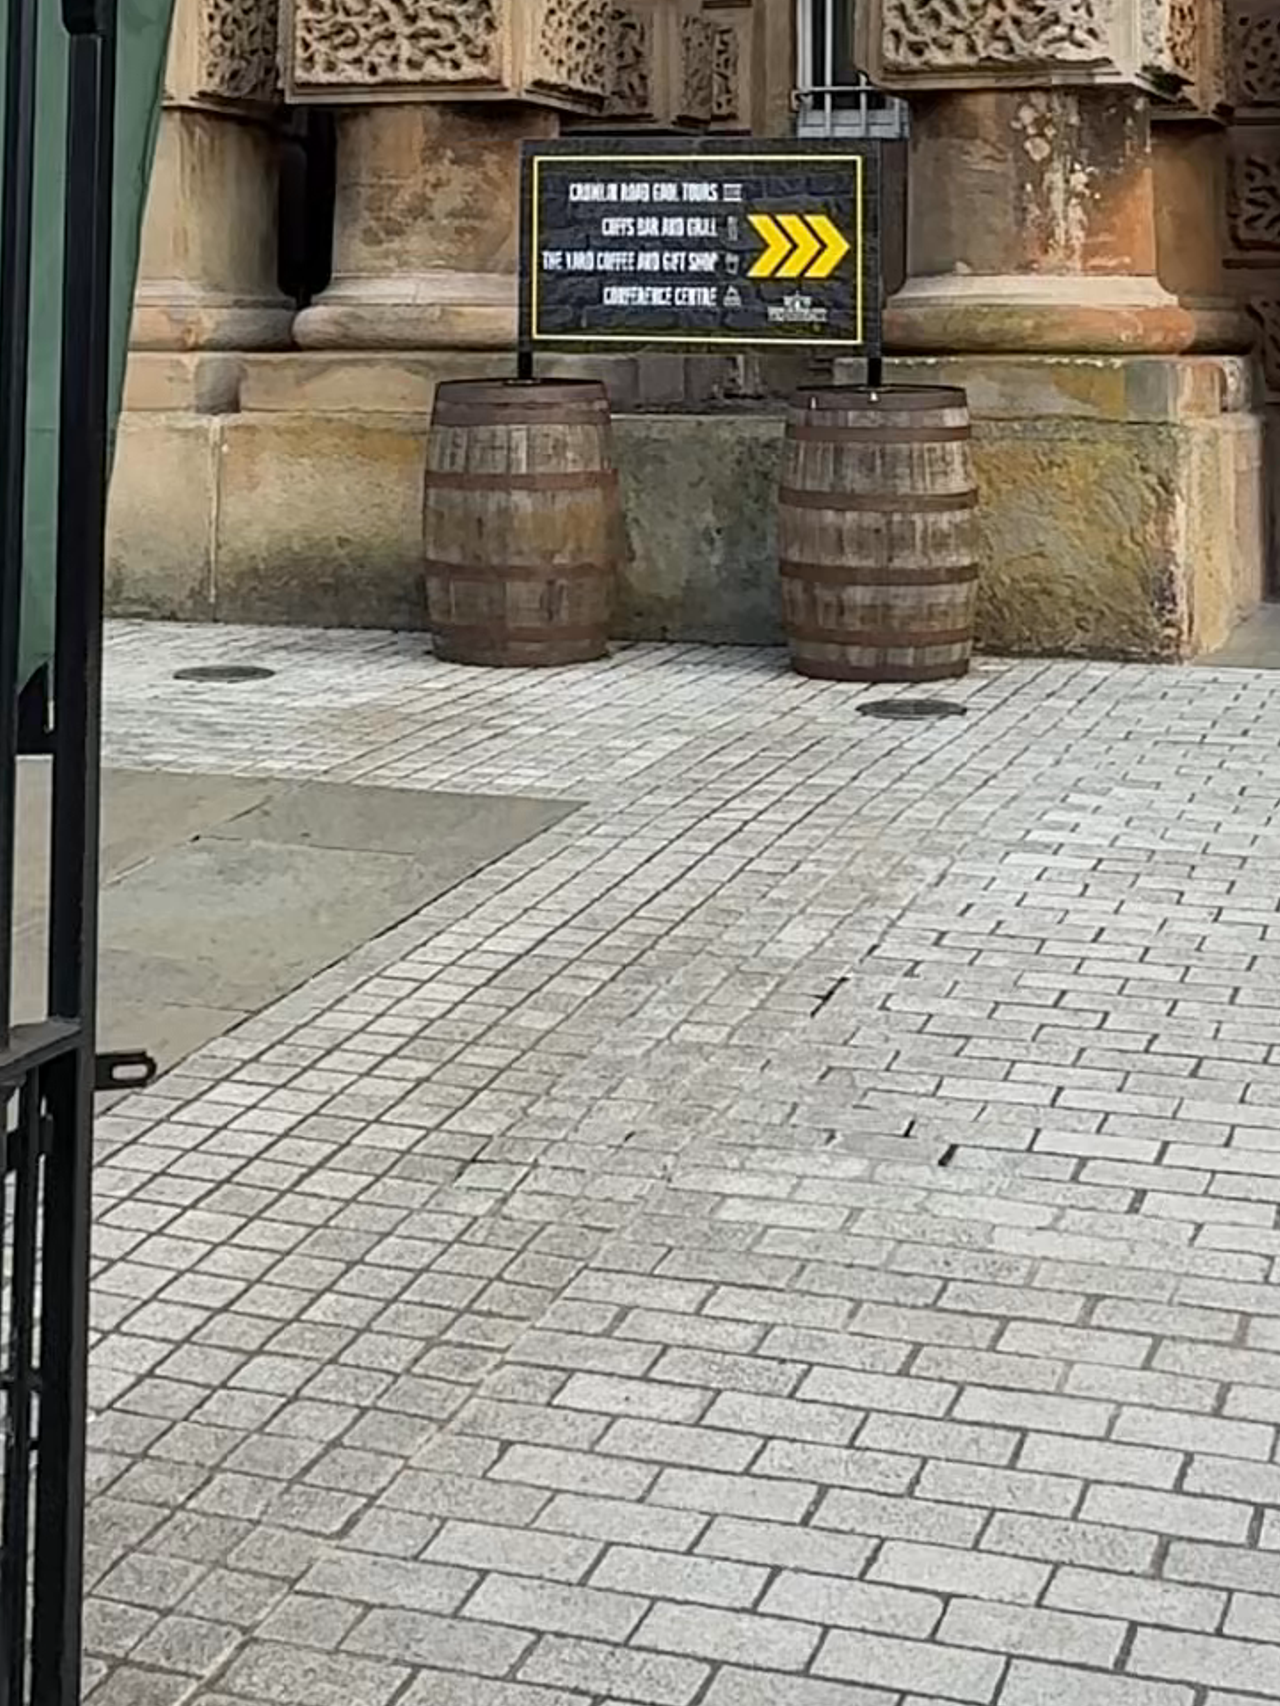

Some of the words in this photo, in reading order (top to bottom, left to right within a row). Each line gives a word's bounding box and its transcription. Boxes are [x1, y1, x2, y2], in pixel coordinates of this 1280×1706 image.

[621, 183, 650, 202] ROAD
[682, 183, 718, 202] TOURS
[602, 217, 635, 236] CUFFS
[637, 217, 660, 236] BAR
[662, 217, 685, 236] AND
[687, 217, 718, 236] GRILL
[542, 251, 564, 270] THE
[565, 251, 594, 270] YARD
[597, 251, 635, 271] COFFEE
[637, 251, 660, 271] AND
[662, 251, 686, 272] GIFT
[688, 251, 718, 272] SHOP
[603, 286, 672, 306] CONFERENCE
[674, 286, 717, 306] CENTRE
